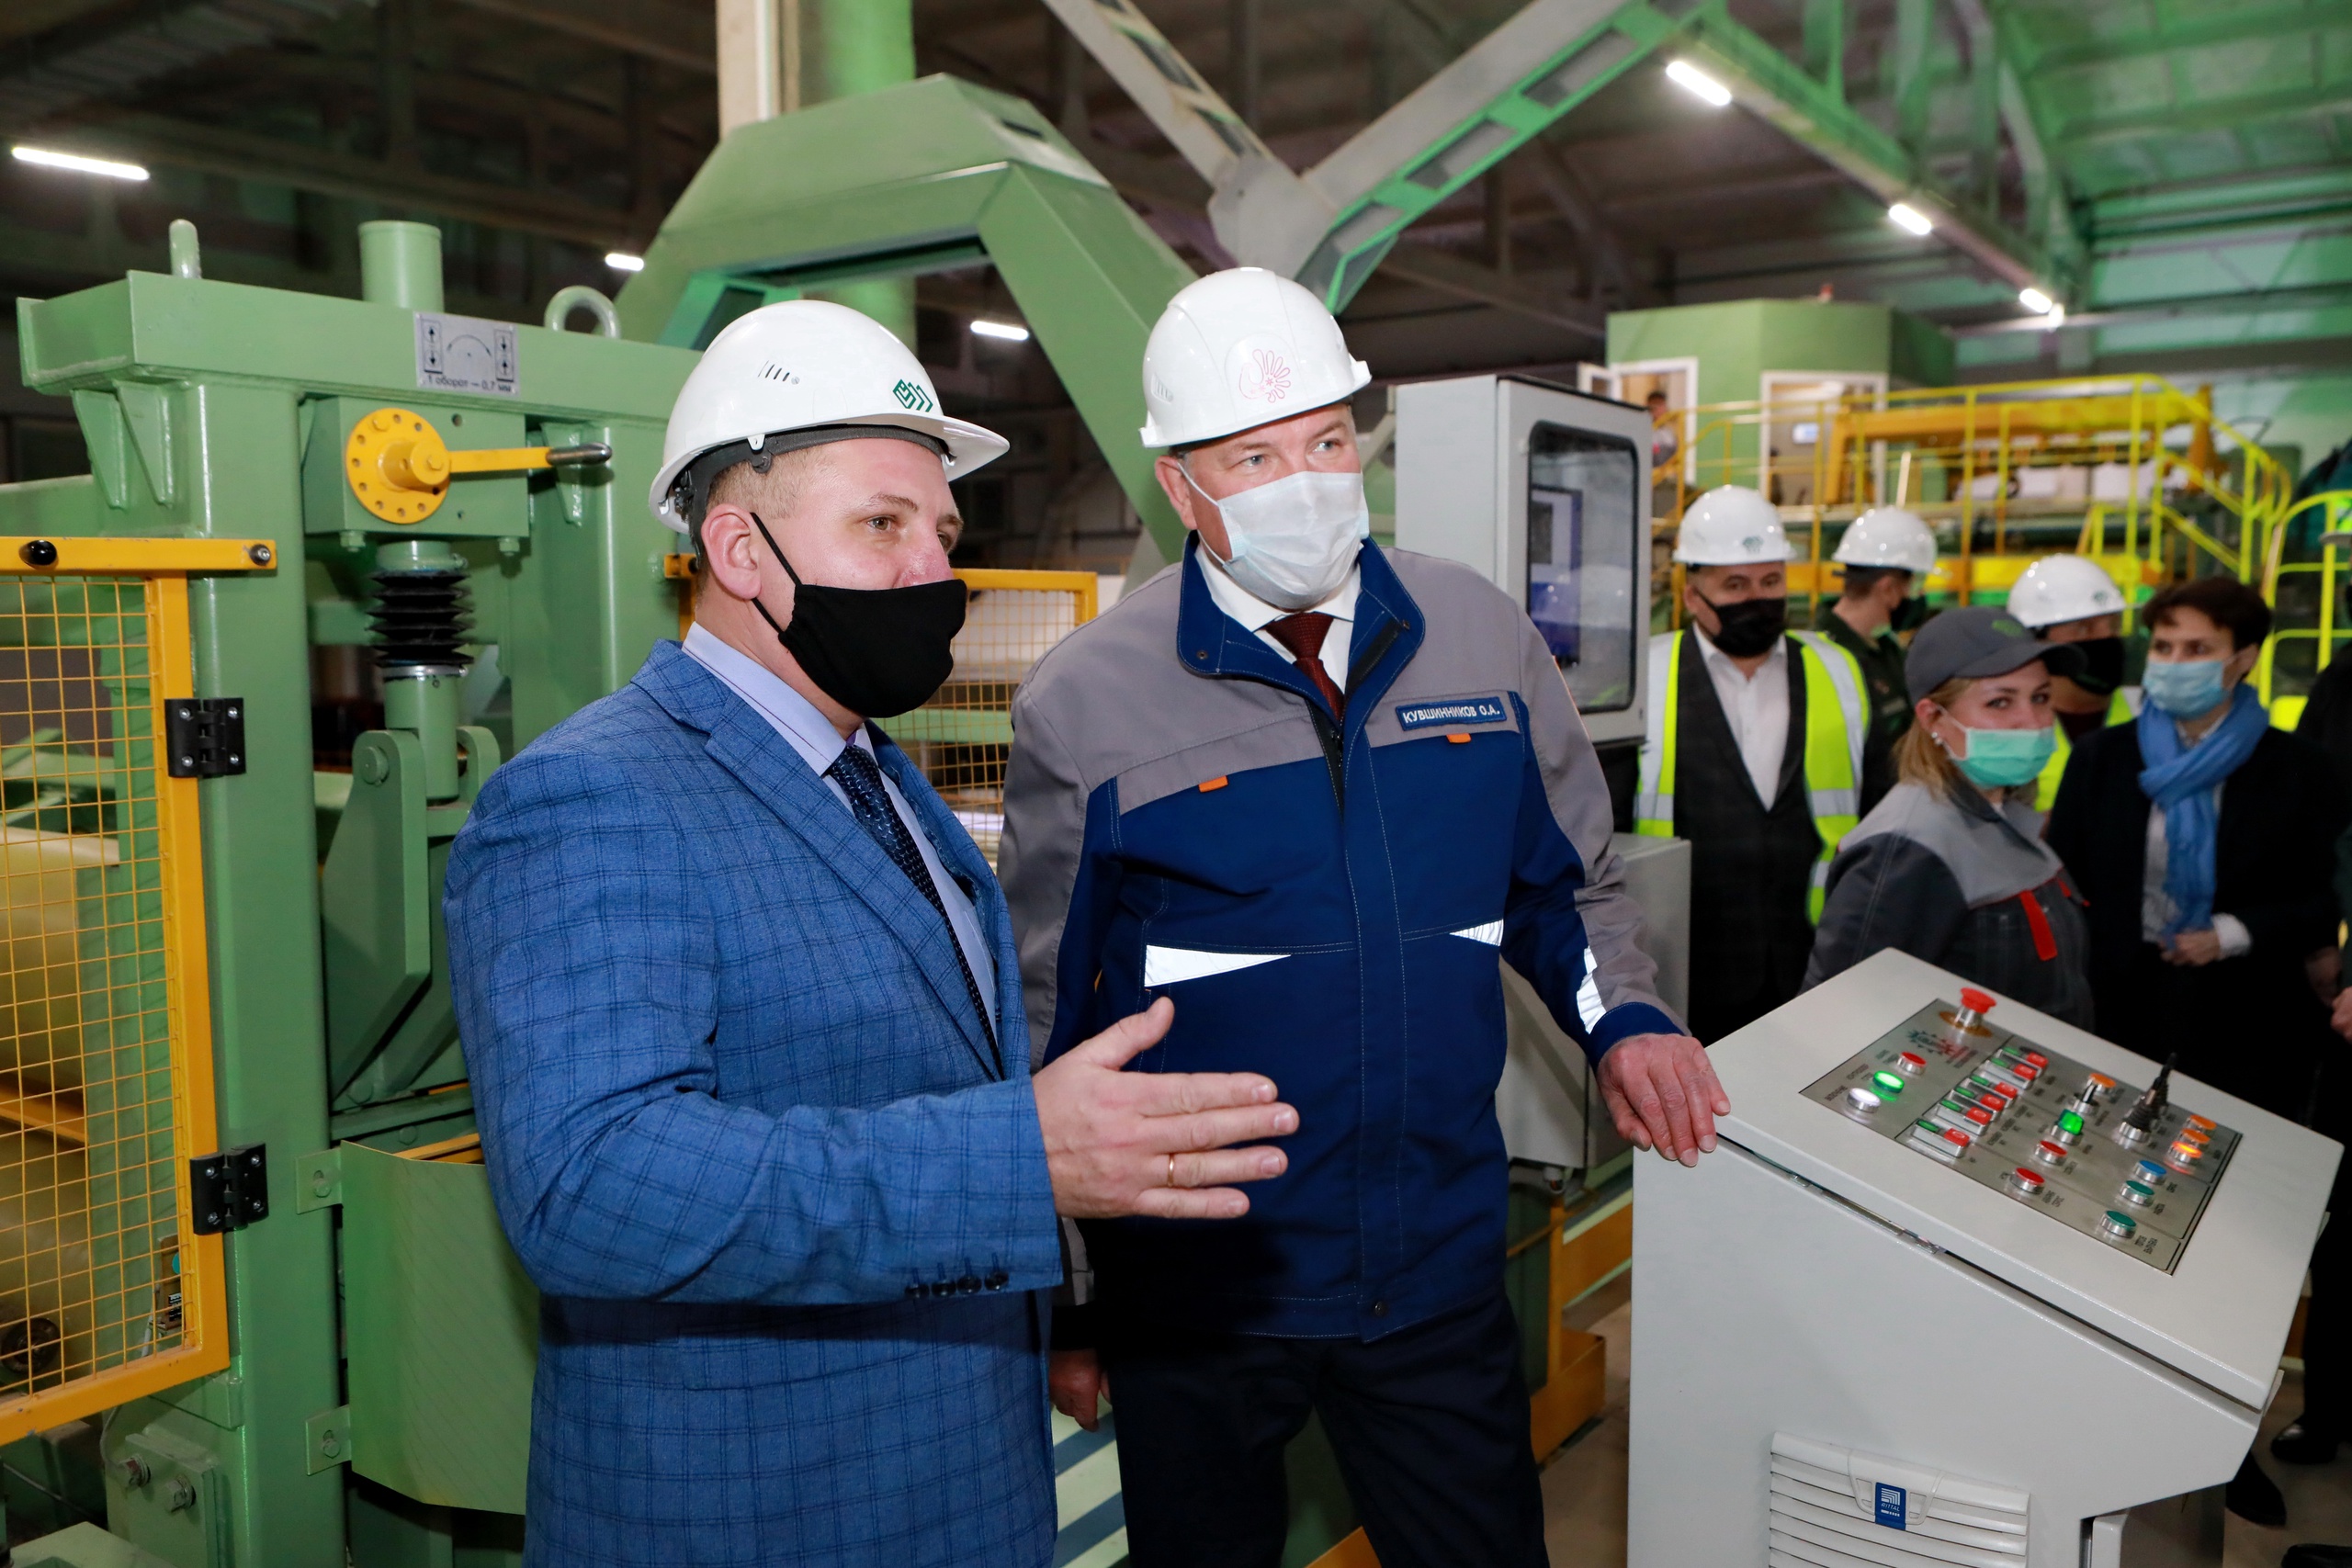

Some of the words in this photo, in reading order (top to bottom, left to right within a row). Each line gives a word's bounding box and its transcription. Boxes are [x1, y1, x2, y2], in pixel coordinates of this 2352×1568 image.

[435, 375, 469, 389] оборот
[1402, 706, 1477, 724] КУВШИННИКОВ
[1478, 705, 1501, 716] О.А.
[1881, 1502, 1900, 1511] RITTAL
